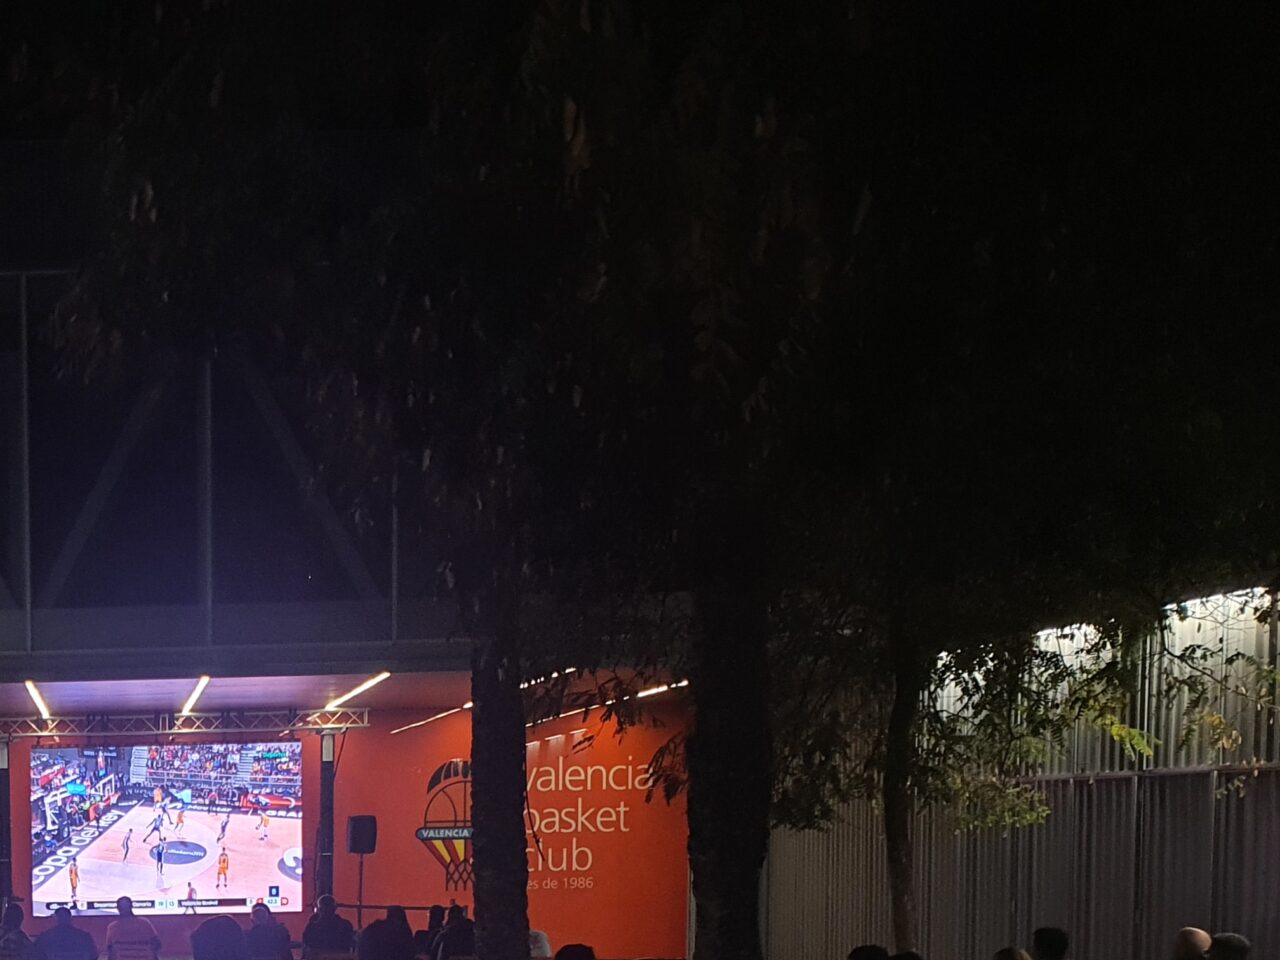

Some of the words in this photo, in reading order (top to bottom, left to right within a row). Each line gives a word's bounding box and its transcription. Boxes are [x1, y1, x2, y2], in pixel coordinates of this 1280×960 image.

[422, 829, 469, 838] VALENCIA
[542, 877, 558, 889] de
[564, 876, 594, 889] 1986
